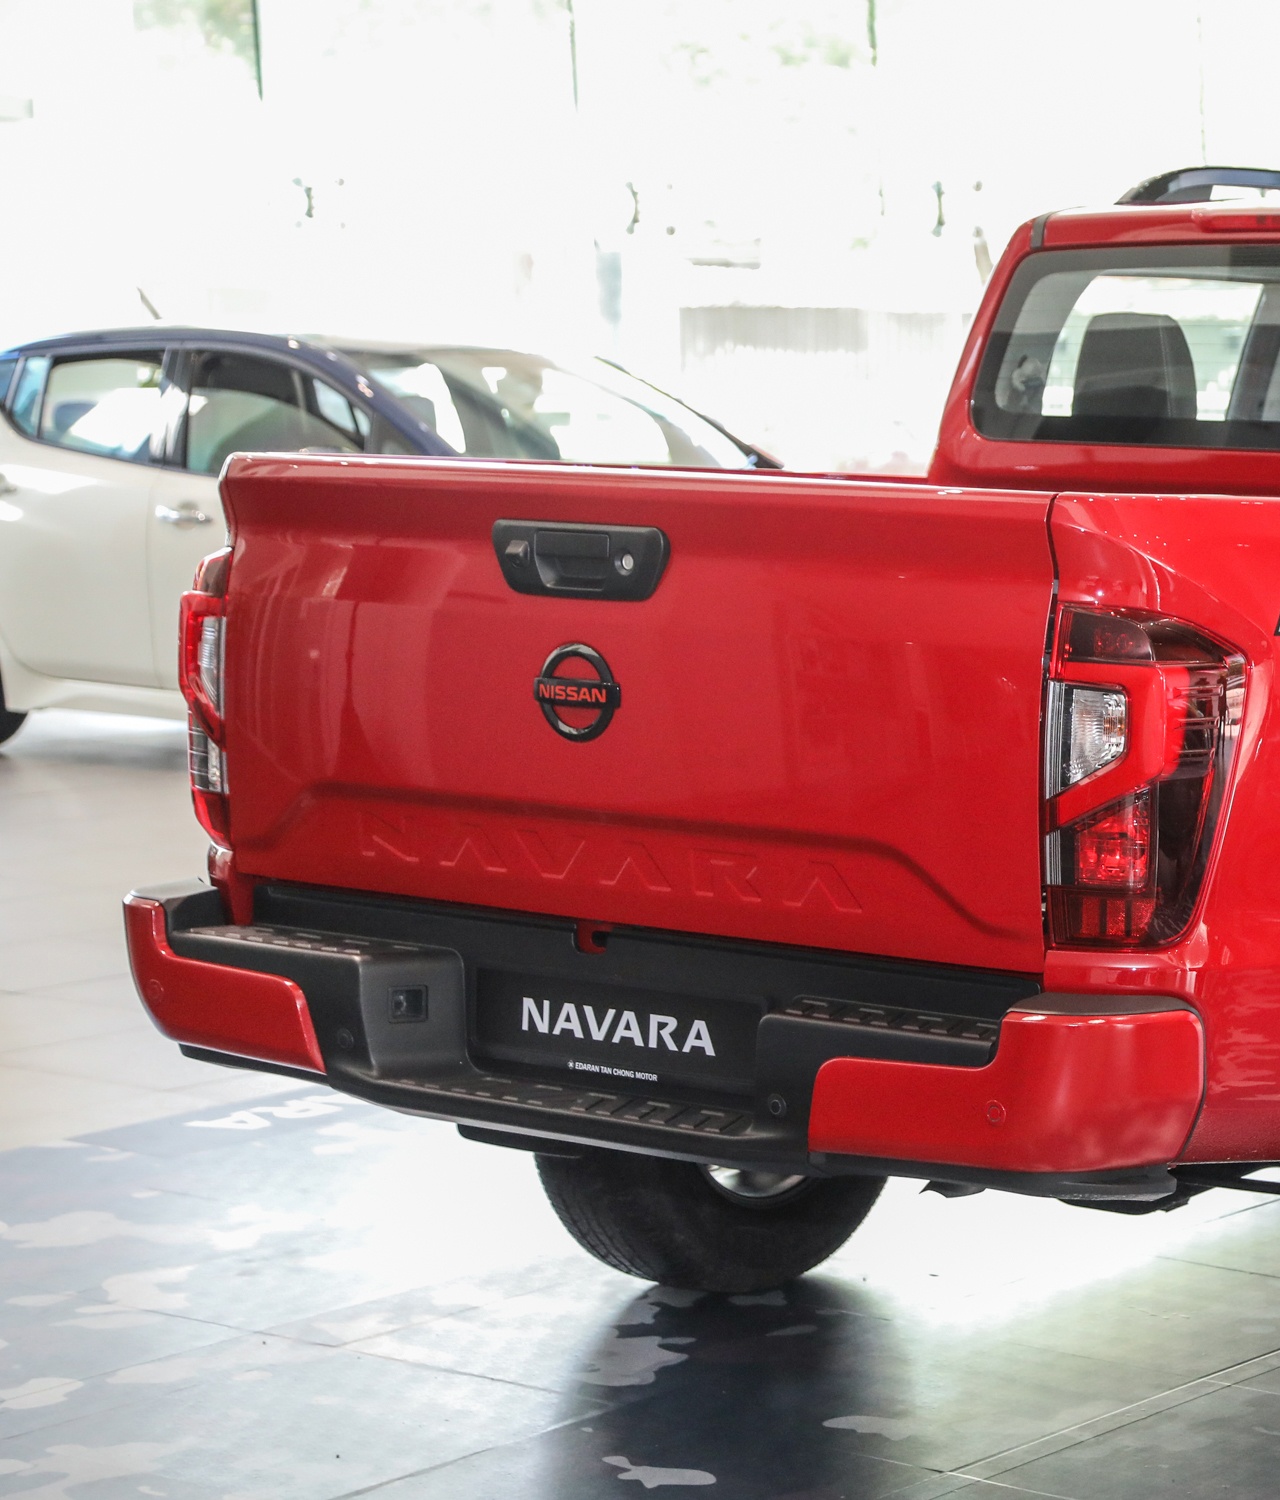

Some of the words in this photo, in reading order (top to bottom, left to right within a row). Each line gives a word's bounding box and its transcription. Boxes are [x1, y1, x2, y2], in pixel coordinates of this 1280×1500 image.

[538, 683, 607, 703] NISSAN
[357, 811, 863, 914] NAVARA
[520, 996, 717, 1057] NAVARA
[575, 1061, 600, 1073] EDARAN
[600, 1065, 612, 1075] TAN
[612, 1068, 634, 1078] CHONG
[635, 1071, 658, 1082] MOTOR
